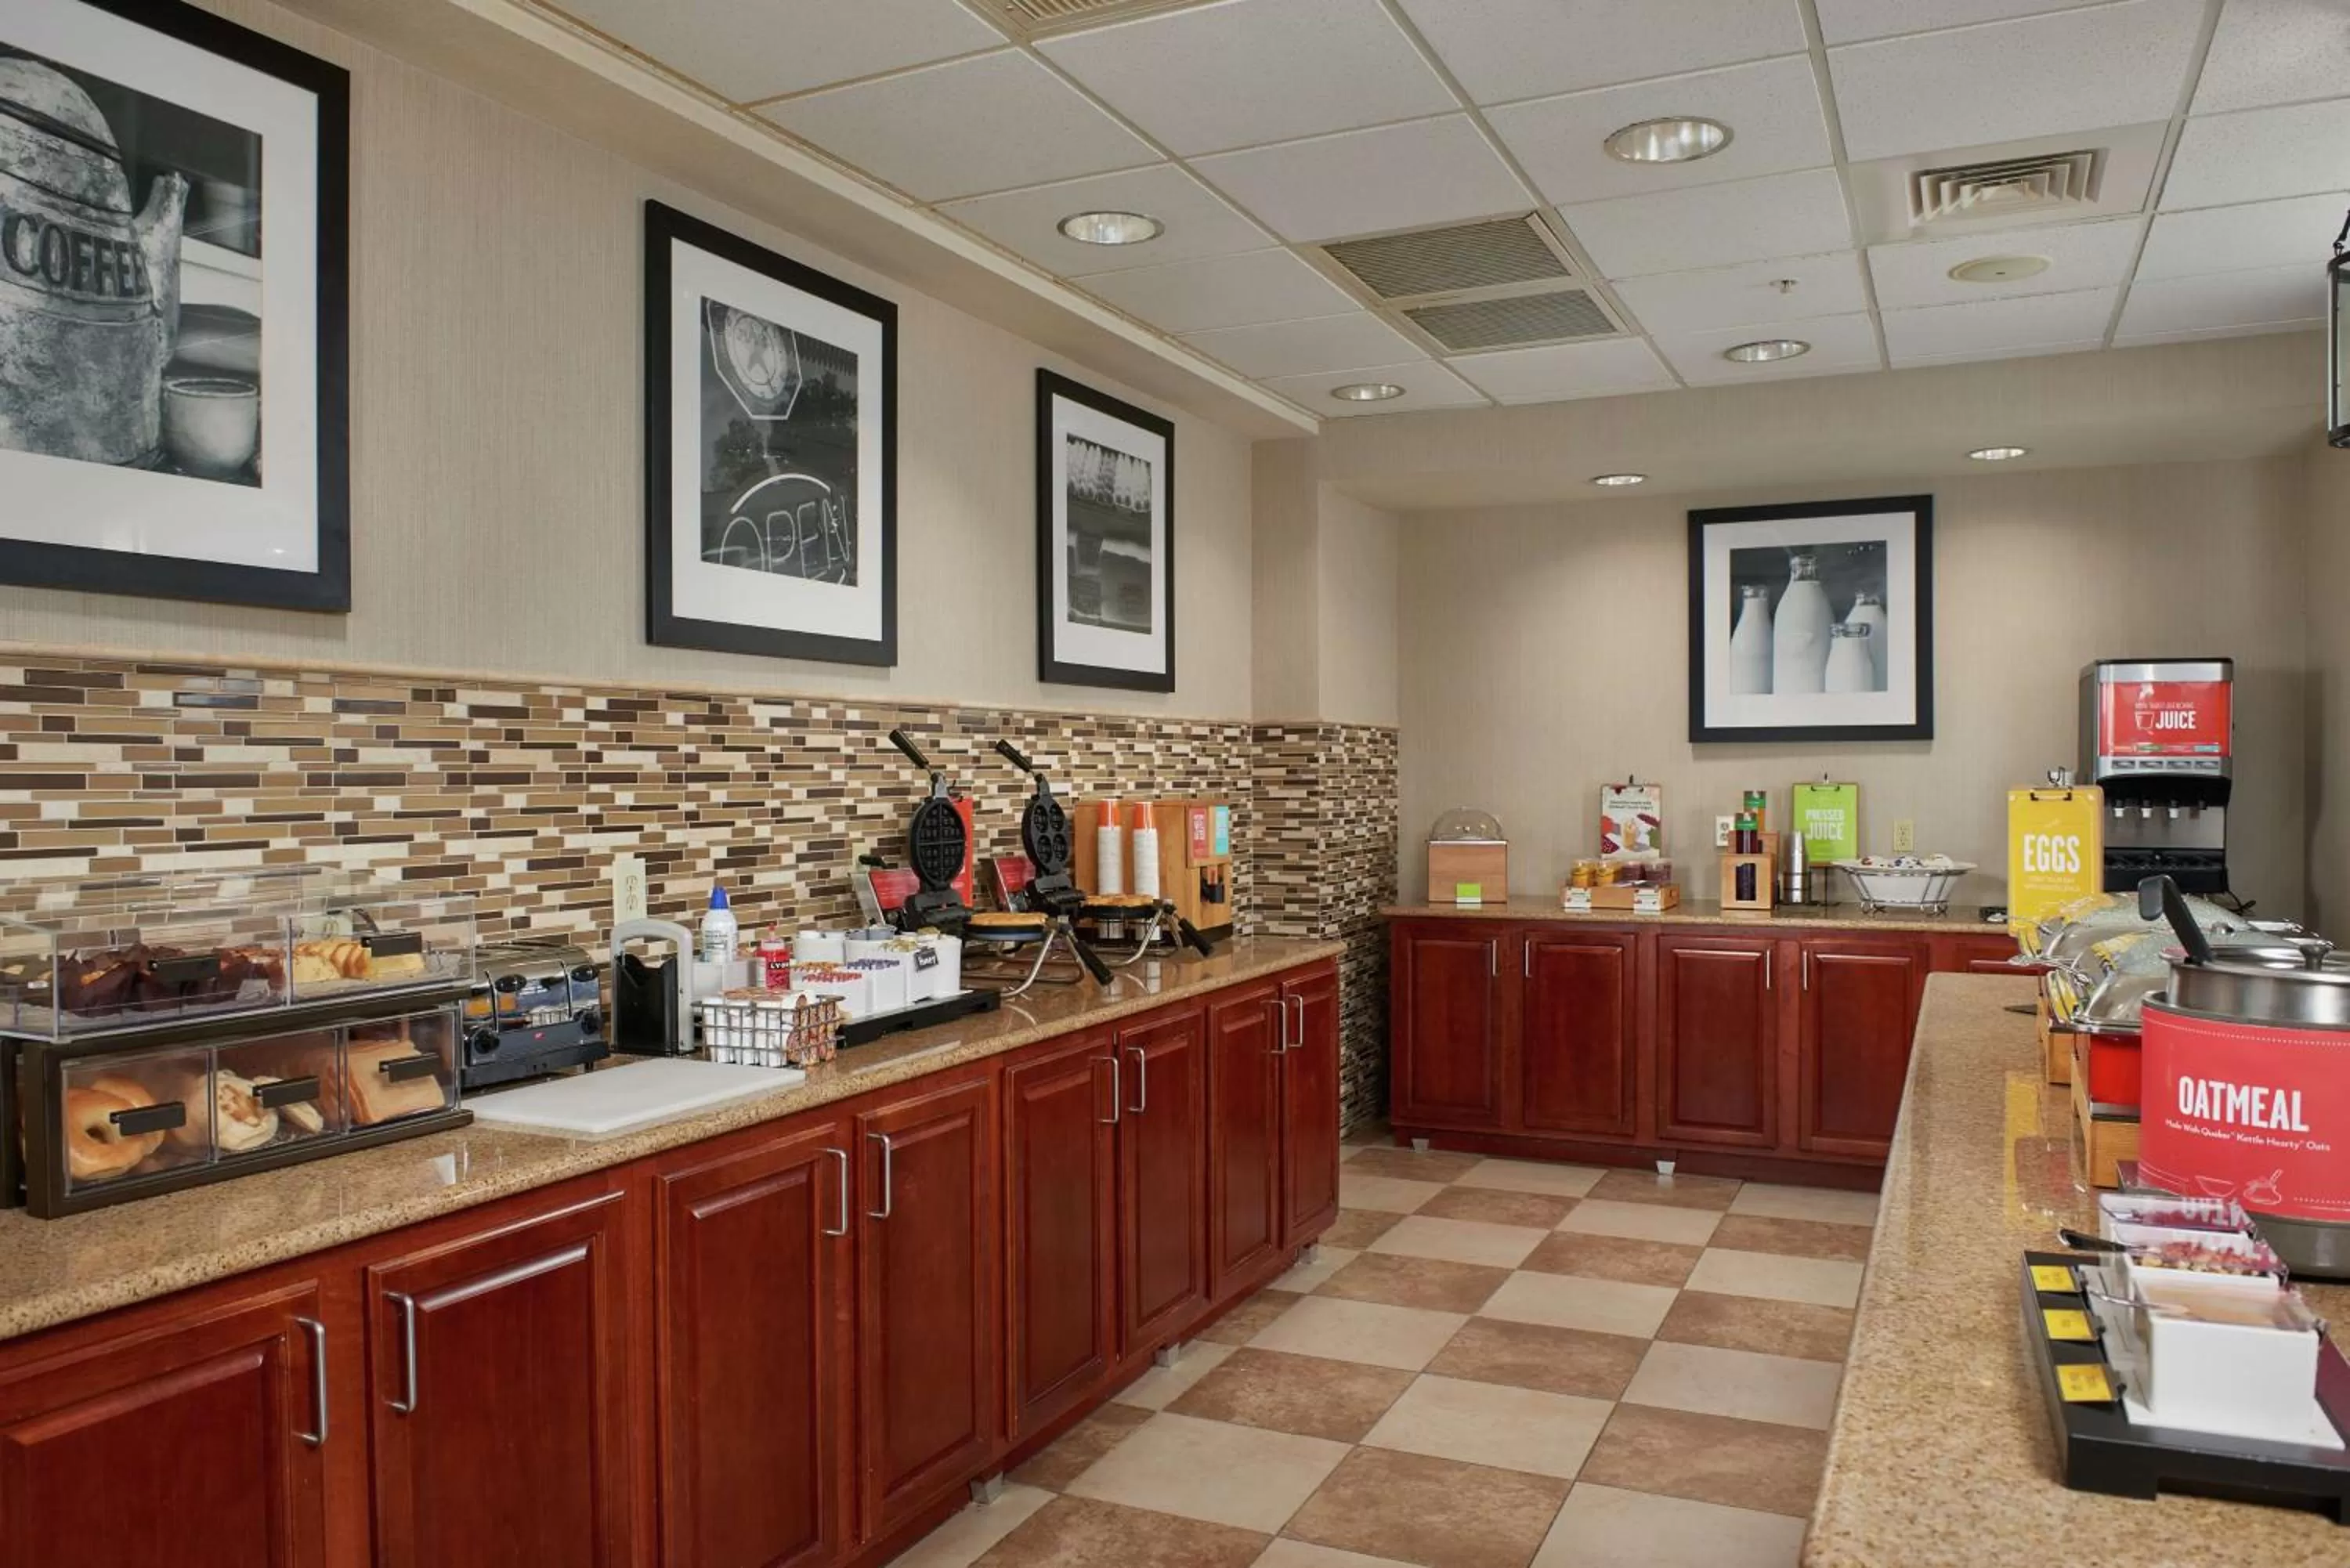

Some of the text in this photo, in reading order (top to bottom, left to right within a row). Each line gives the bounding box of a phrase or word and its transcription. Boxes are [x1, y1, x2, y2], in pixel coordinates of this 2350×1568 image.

[2, 214, 150, 297] COFFEE
[719, 495, 851, 578] OPEN
[2156, 710, 2196, 729] JUICE
[1805, 822, 1844, 840] JUICE
[2023, 834, 2081, 873] EGGS
[2178, 1075, 2310, 1132] OATMEAL
[2165, 1118, 2182, 1129] Made
[2183, 1124, 2200, 1134] With
[2236, 1133, 2265, 1144] Kettle
[2306, 1141, 2331, 1152] Oats
